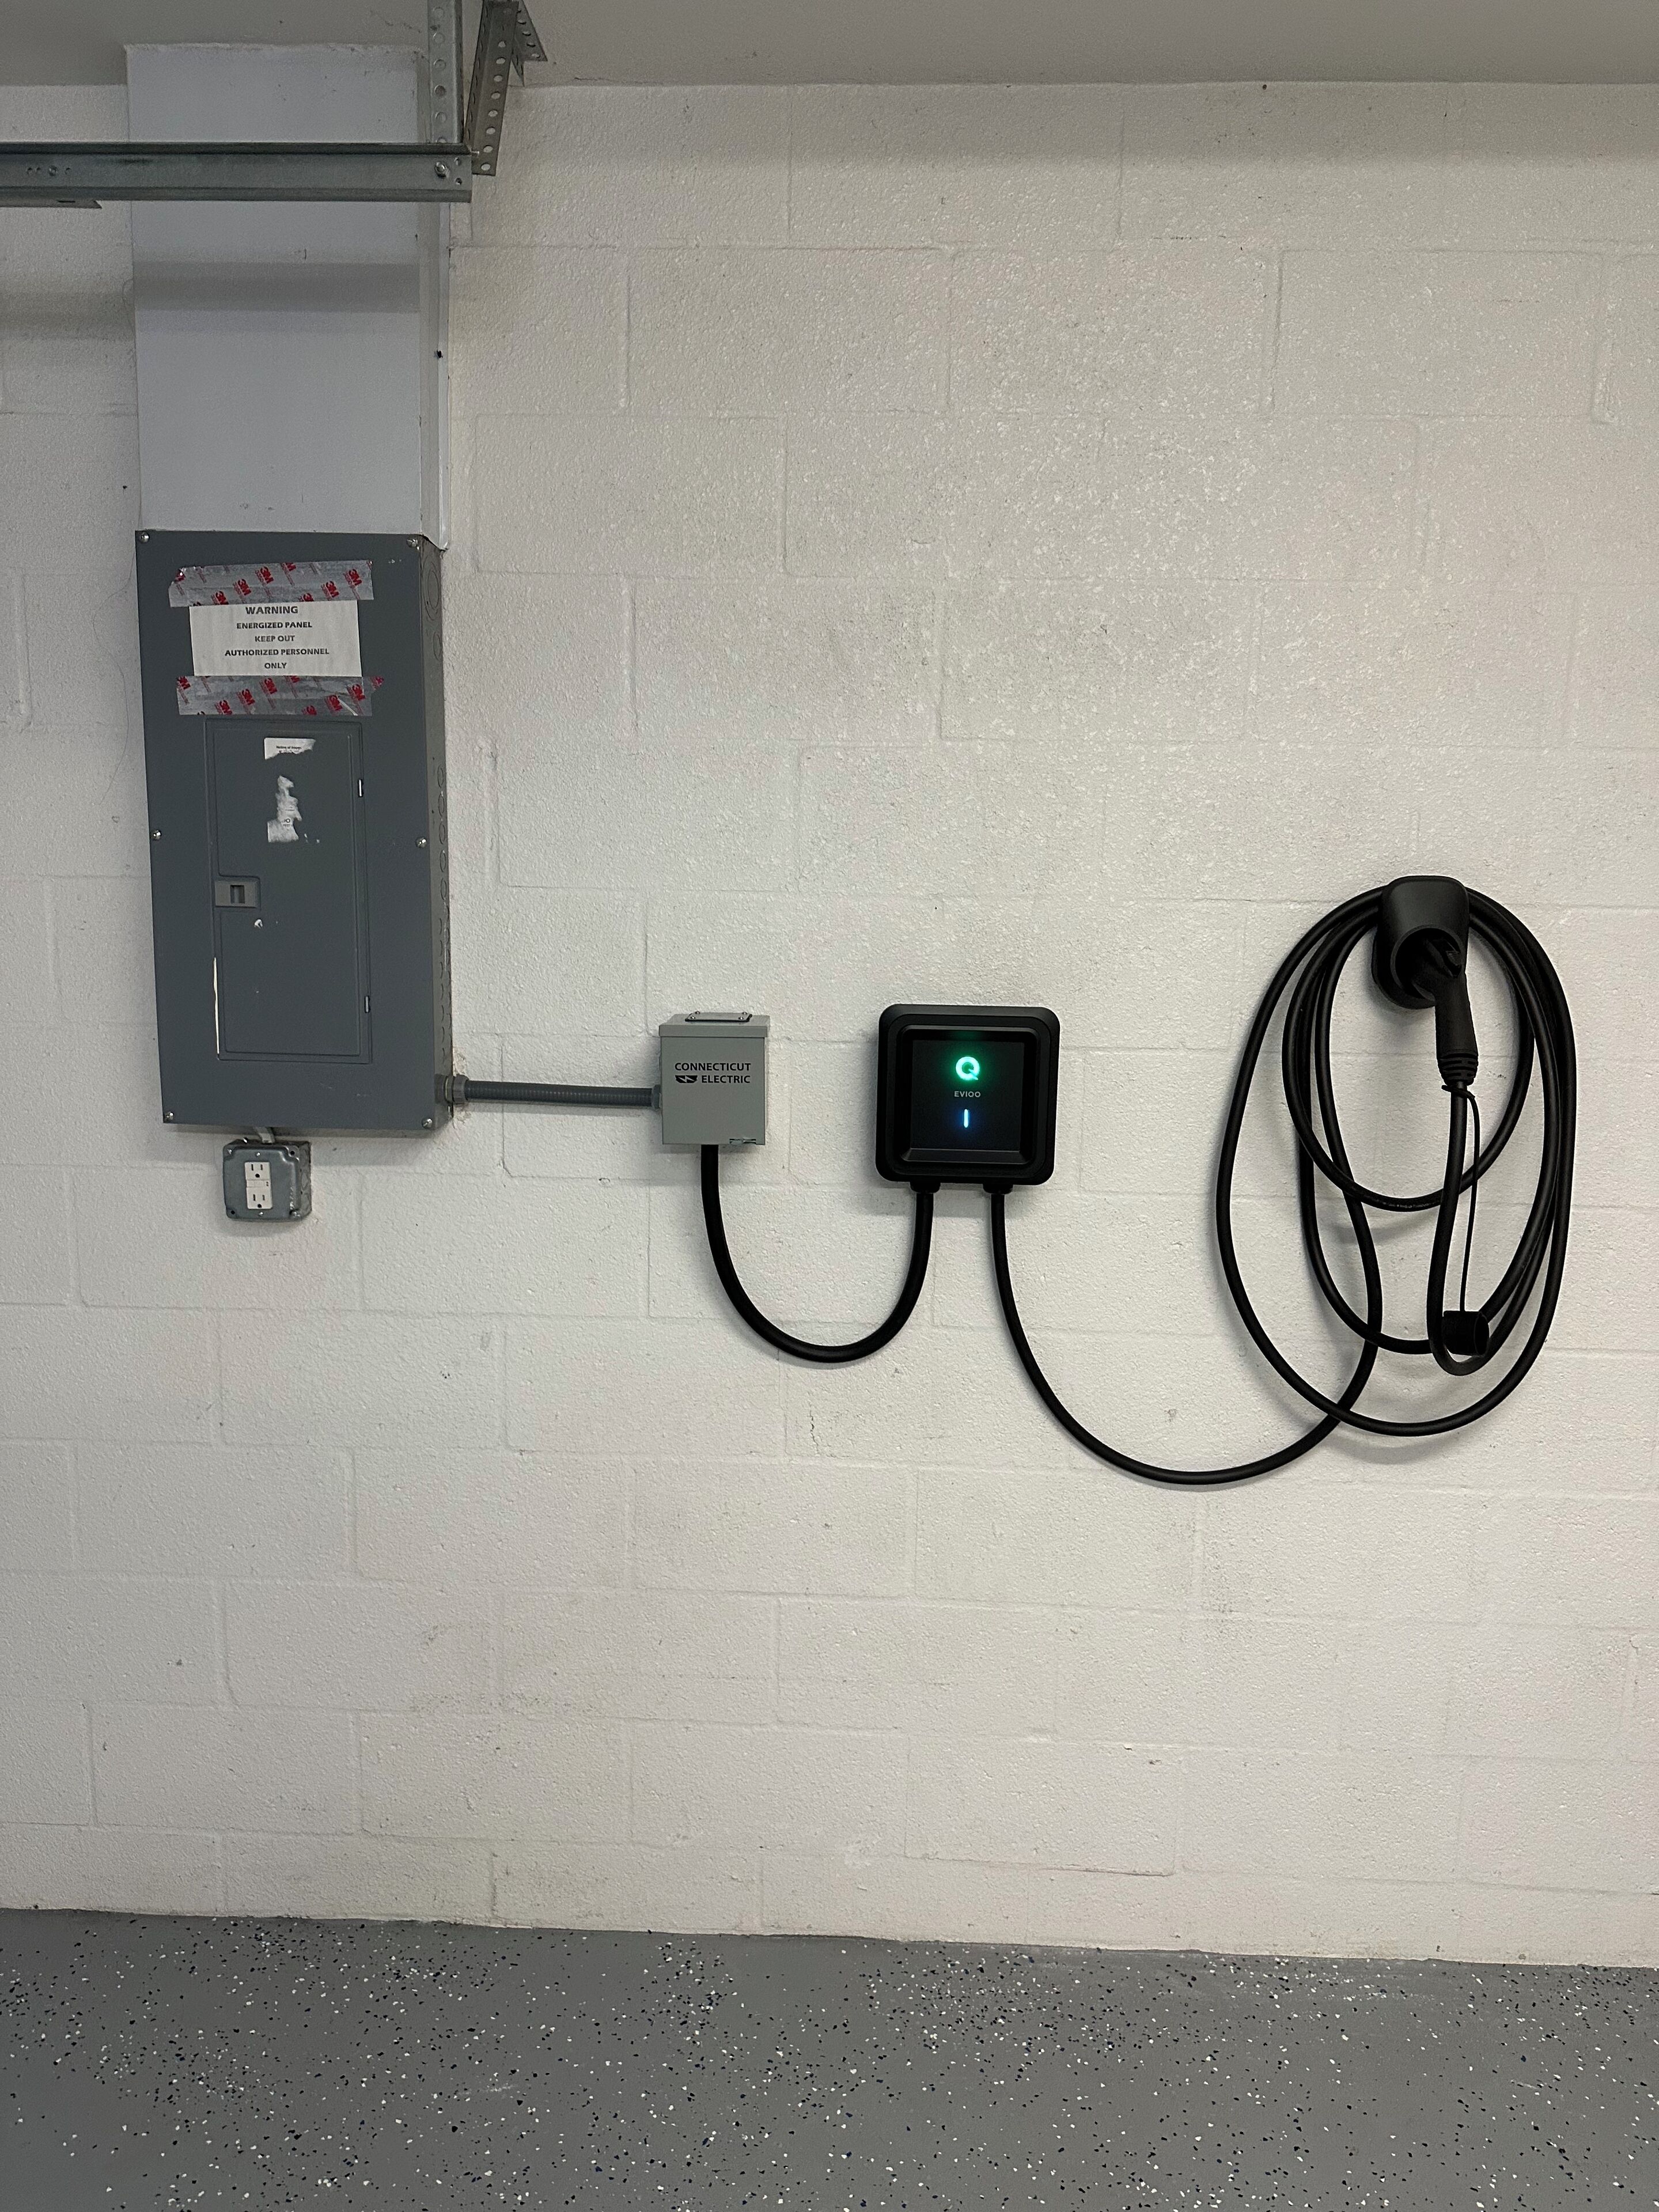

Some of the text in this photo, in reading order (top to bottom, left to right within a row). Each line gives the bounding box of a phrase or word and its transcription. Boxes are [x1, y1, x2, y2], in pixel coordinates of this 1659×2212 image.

[260, 566, 274, 584] 3M
[348, 569, 363, 586] 3M
[237, 578, 252, 596] 3M
[325, 580, 340, 598] 3M
[245, 605, 298, 615] WARNING
[264, 677, 278, 695] 3M
[351, 683, 366, 701] 3M
[241, 688, 256, 706] 3M
[674, 1062, 751, 1071] CONNECTICUT
[701, 1075, 751, 1084] ELECTRIC
